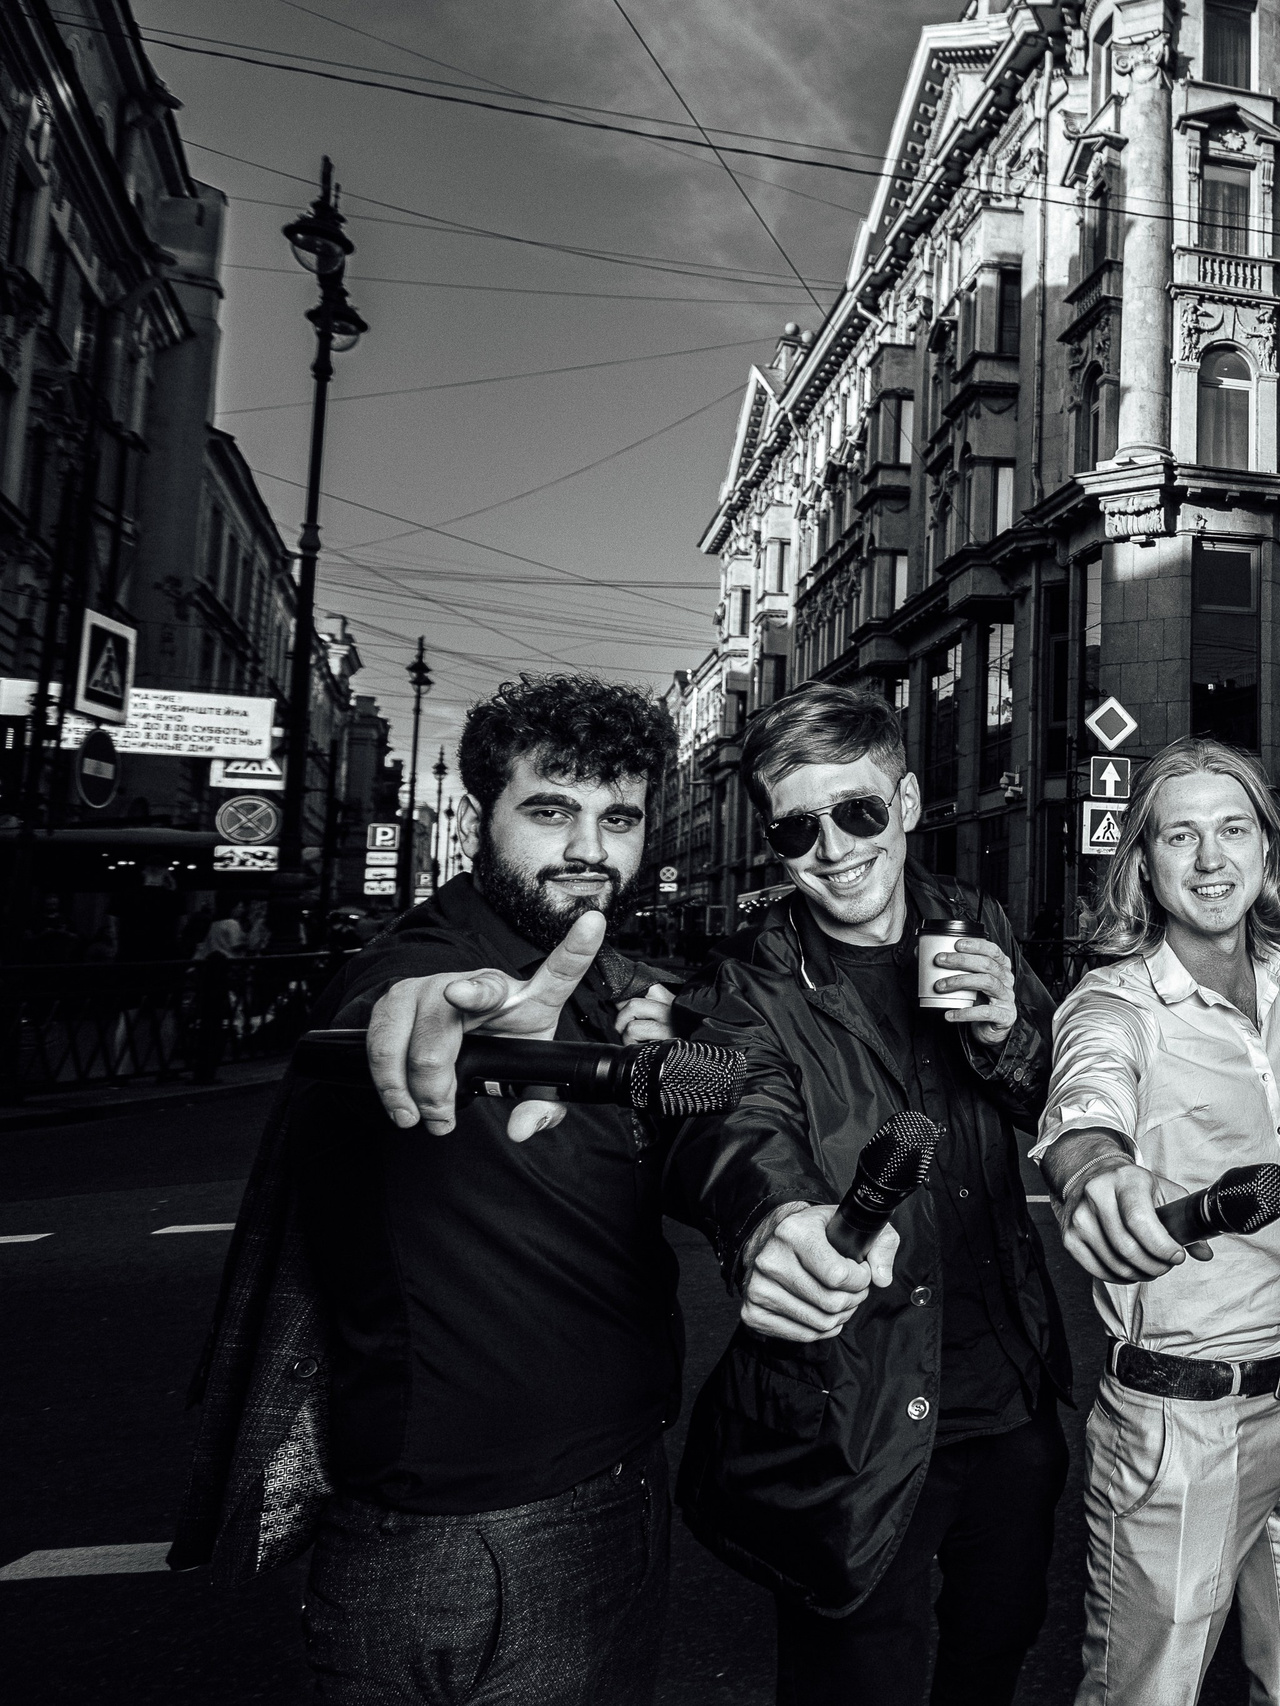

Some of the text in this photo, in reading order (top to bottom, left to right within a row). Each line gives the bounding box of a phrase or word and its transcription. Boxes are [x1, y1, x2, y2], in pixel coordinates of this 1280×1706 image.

[154, 703, 249, 717] РУБИНШТЕЙНА
[191, 725, 250, 736] СУББОТЫ
[172, 733, 262, 746] ВОСКРЕСЕНЬЯ
[186, 744, 214, 753] ДНИ
[375, 827, 394, 846] P
